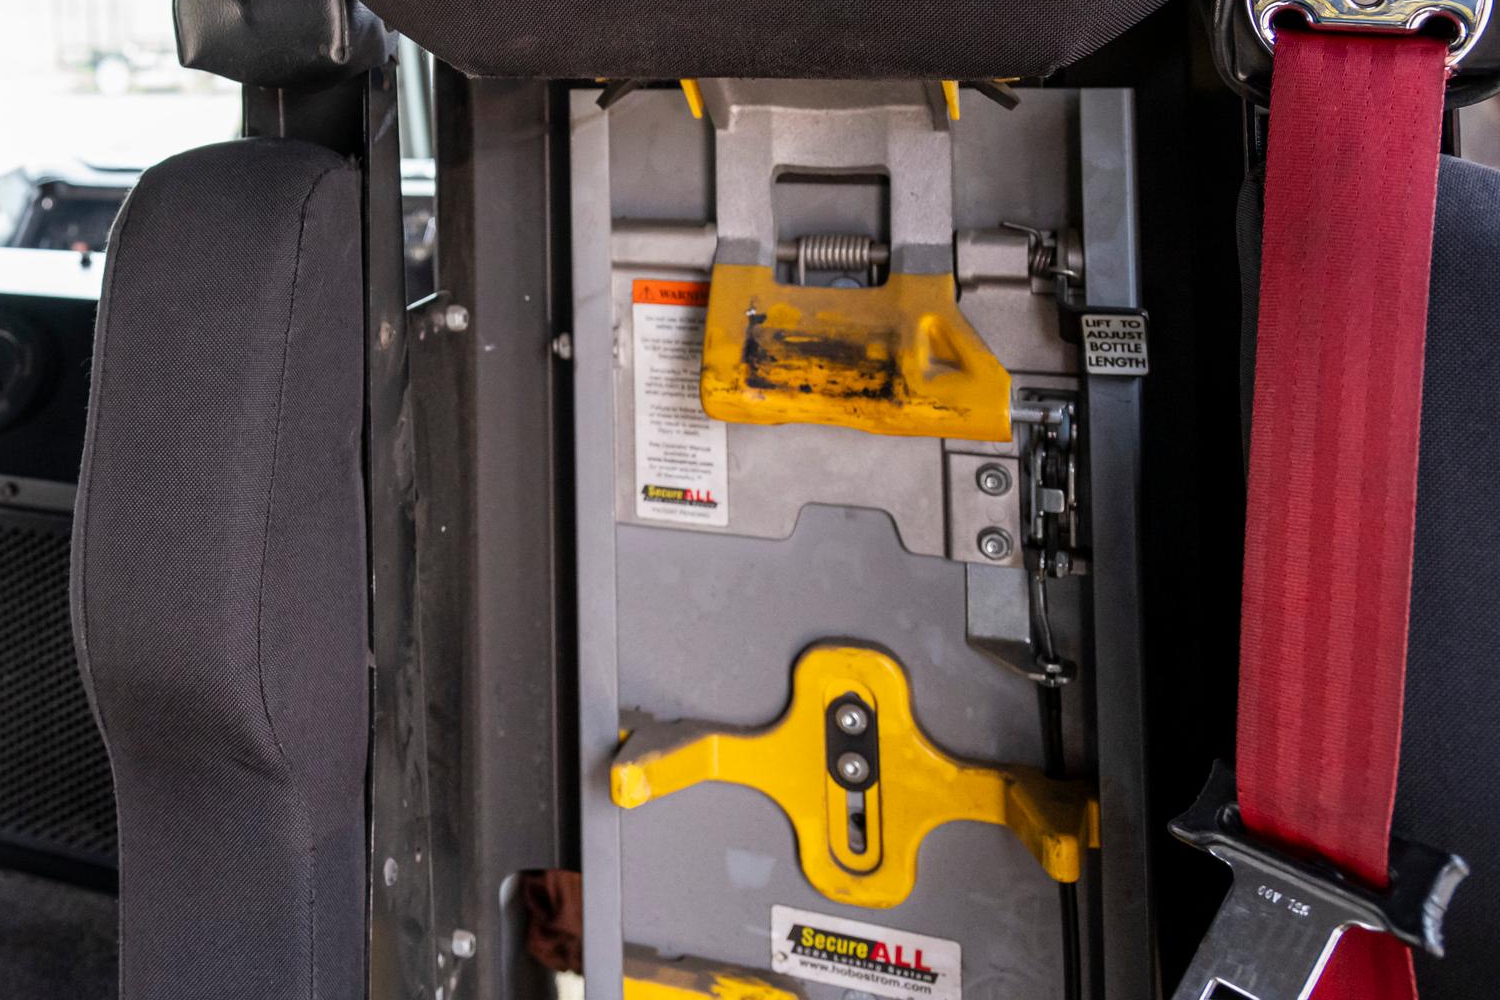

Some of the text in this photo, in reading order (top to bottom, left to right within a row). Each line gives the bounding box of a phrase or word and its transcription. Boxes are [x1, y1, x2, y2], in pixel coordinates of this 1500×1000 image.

[1085, 319, 1141, 329] LIFT TO
[1087, 330, 1143, 340] ADJUST
[1090, 342, 1142, 354] BOTTLE
[1088, 355, 1146, 369] LENGTH
[801, 926, 932, 972] SecureALL
[799, 959, 932, 995] www.hobostrom.com
